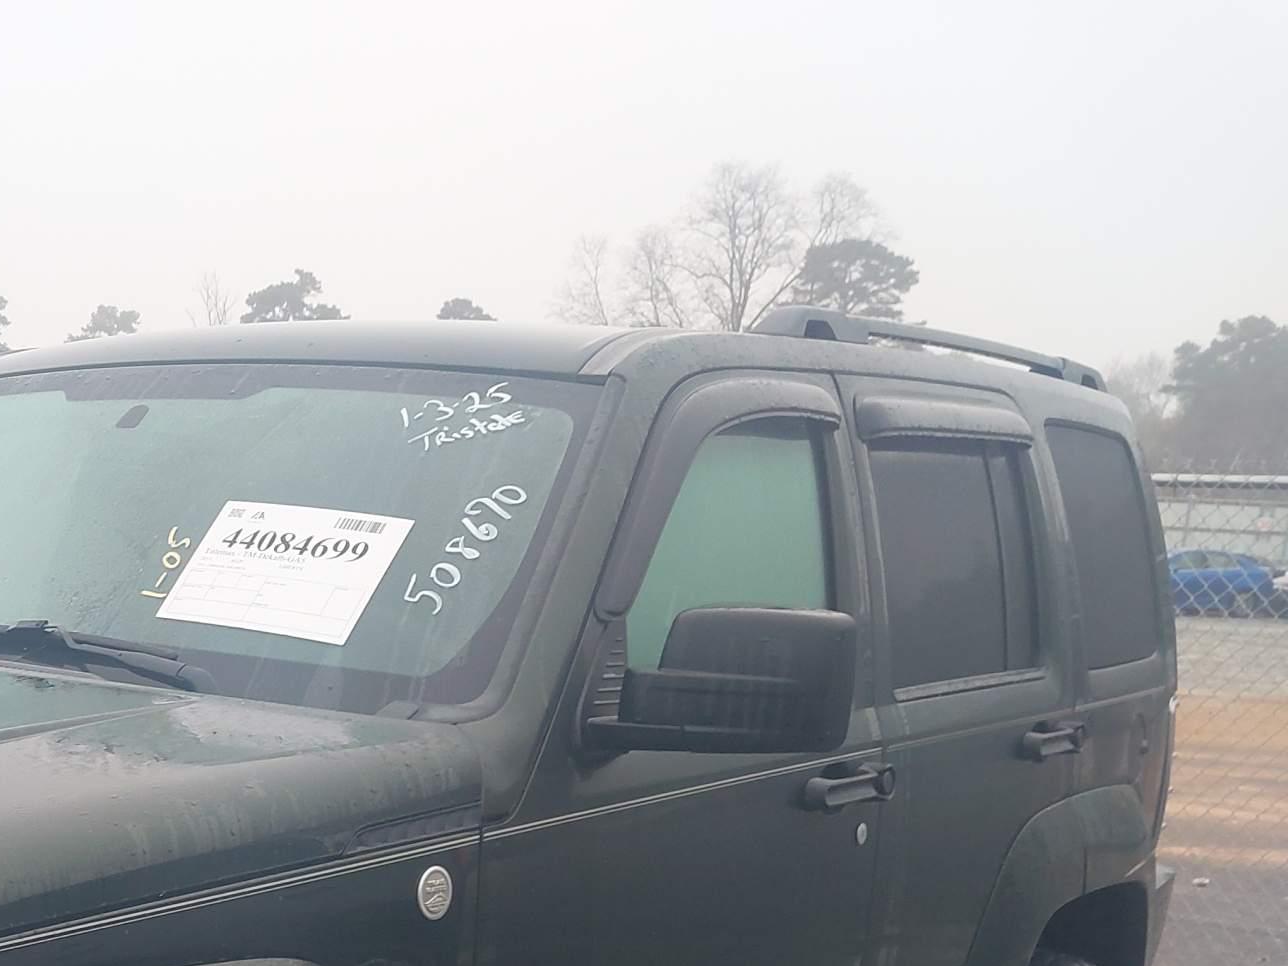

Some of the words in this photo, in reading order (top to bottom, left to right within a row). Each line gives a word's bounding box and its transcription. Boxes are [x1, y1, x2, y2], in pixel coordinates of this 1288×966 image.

[400, 382, 512, 428] 1-3-25
[221, 527, 370, 563] 44084699
[403, 485, 528, 616] 508670
